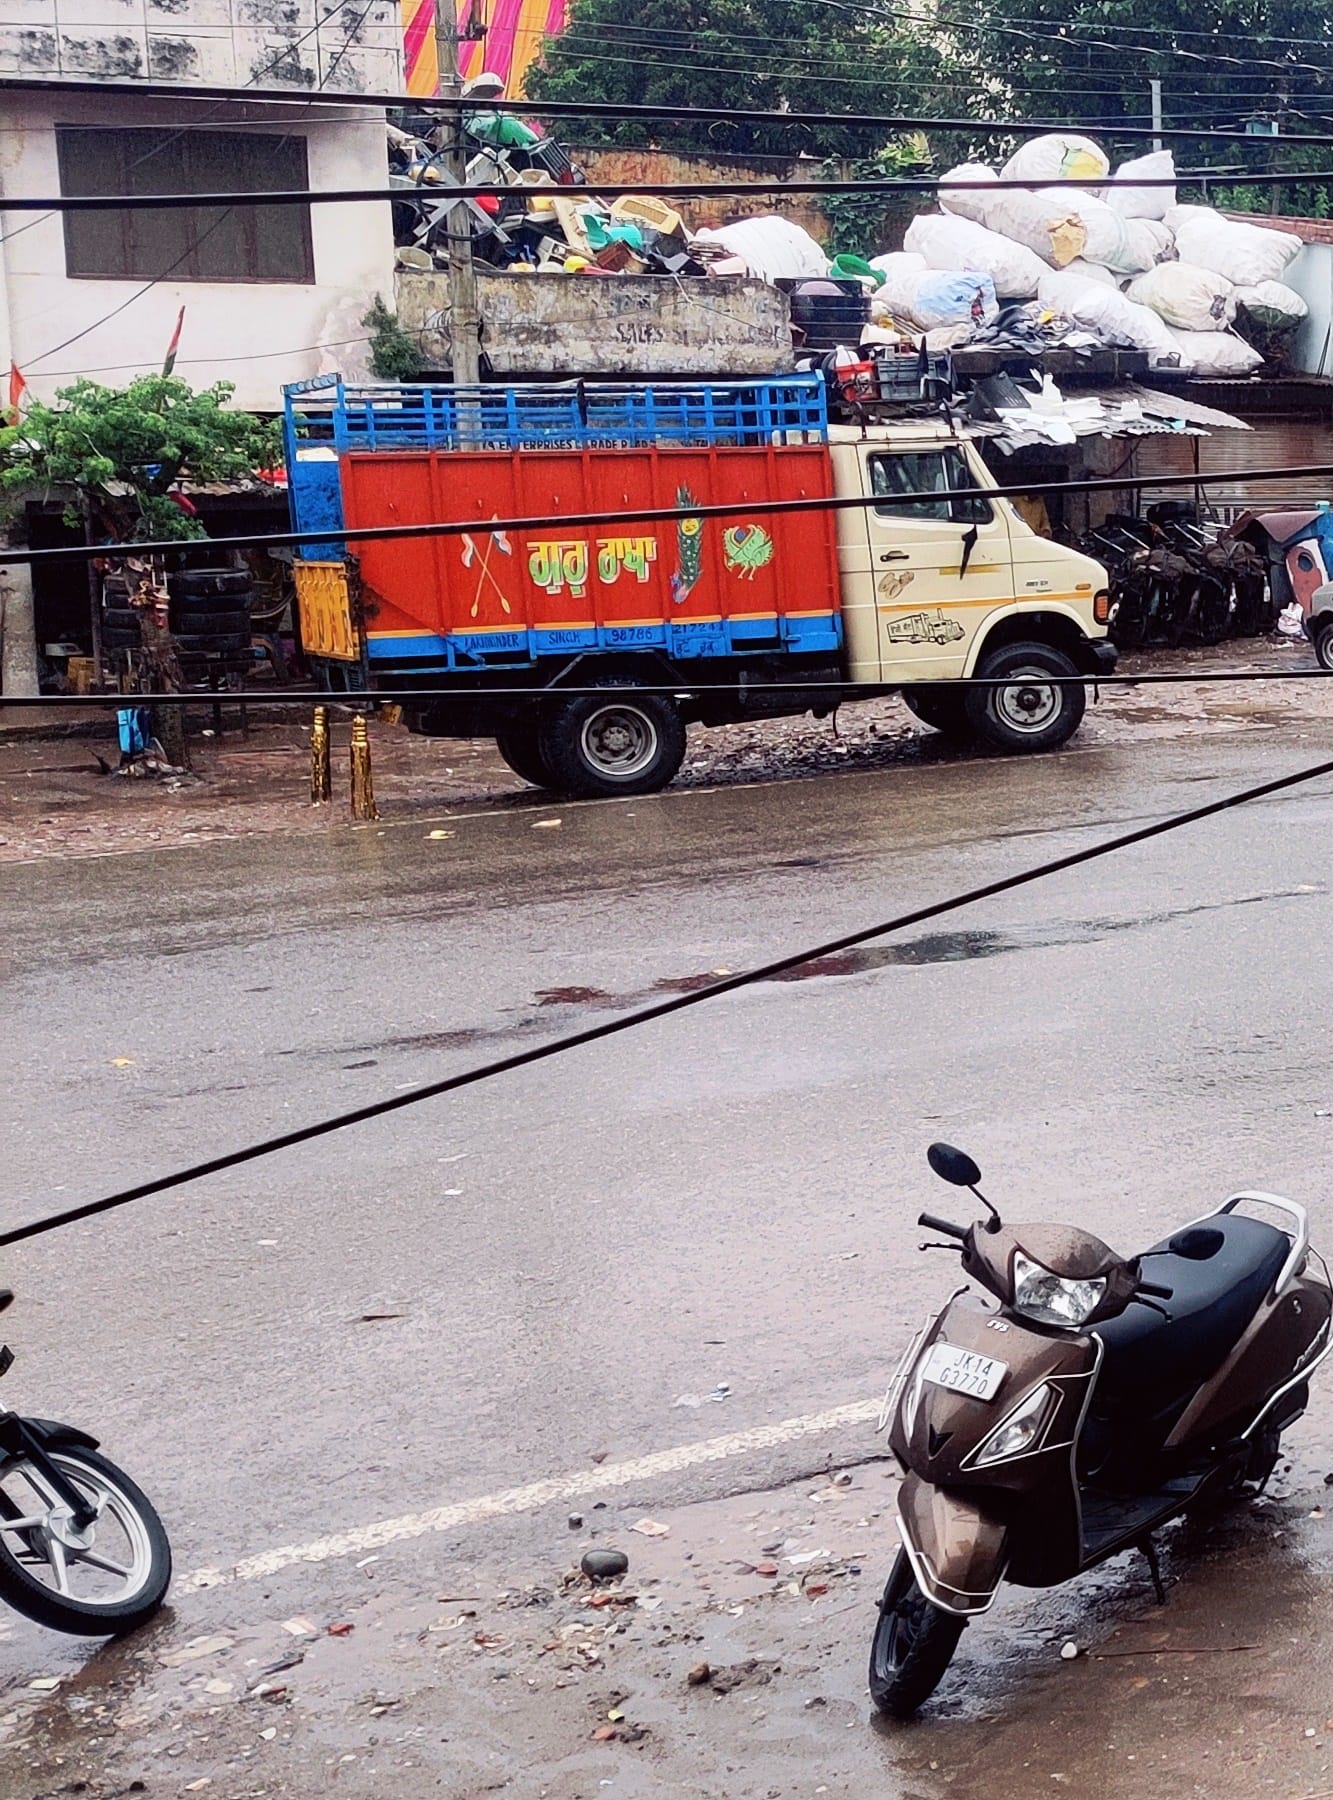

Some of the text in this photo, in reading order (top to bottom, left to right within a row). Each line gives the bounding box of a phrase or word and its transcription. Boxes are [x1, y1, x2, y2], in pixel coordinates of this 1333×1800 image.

[499, 439, 573, 451] ENERPRISES
[953, 1352, 994, 1376] JK14
[940, 1367, 988, 1394] G3770
